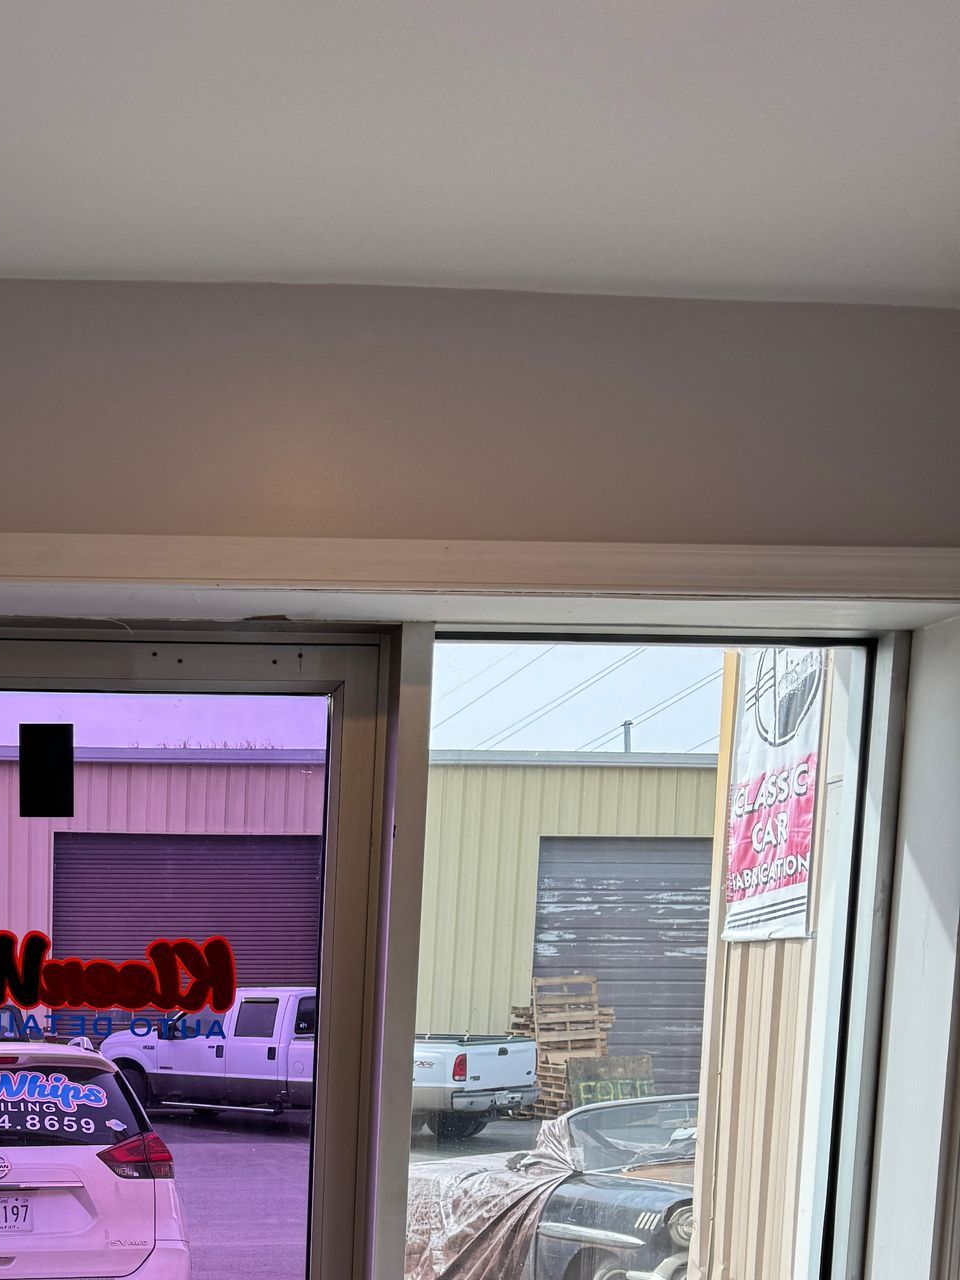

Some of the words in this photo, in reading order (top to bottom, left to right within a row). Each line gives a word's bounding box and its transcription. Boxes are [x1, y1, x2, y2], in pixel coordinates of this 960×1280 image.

[734, 762, 809, 818] CLASSIC
[751, 811, 789, 854] CAR
[732, 852, 810, 891] FABRICATION
